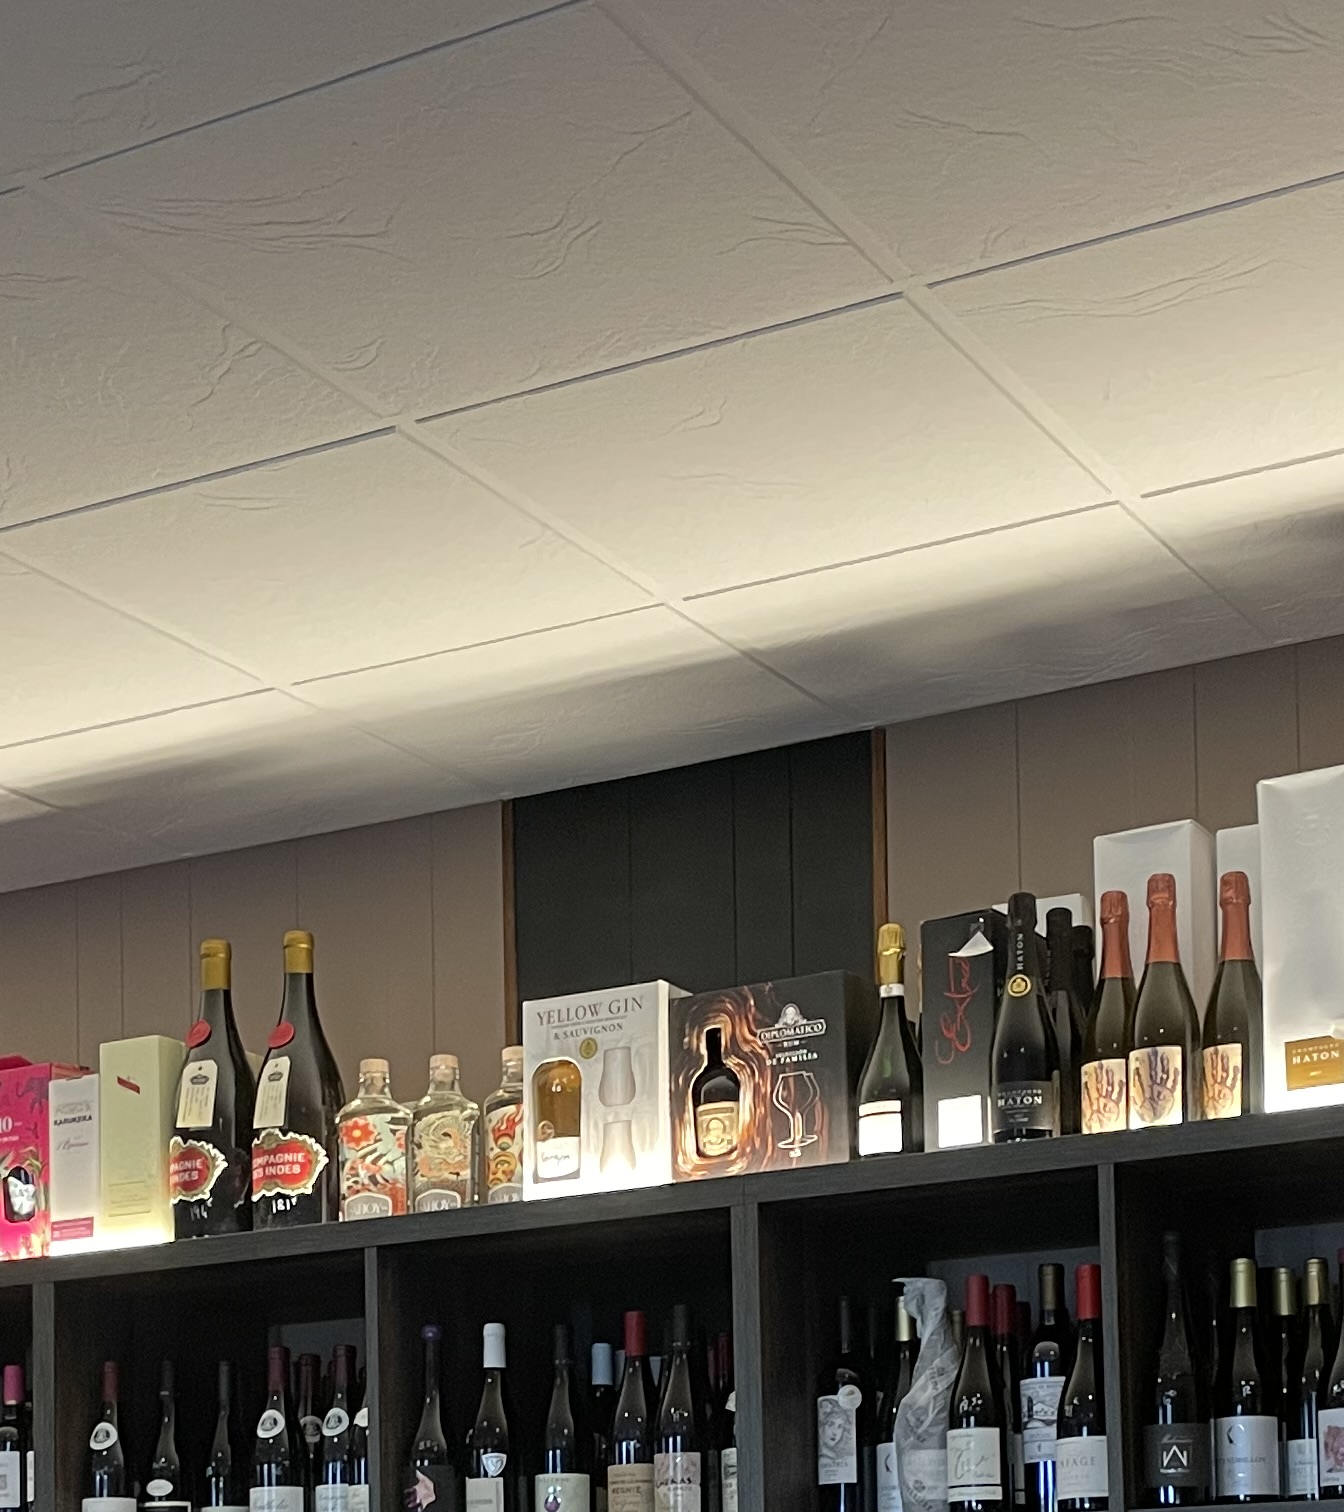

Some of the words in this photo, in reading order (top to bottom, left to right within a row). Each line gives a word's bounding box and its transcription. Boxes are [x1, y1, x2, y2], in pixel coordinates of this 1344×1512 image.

[537, 1002, 603, 1026] YELLOW
[609, 996, 644, 1015] GIN
[553, 1032, 560, 1040] &
[563, 1023, 623, 1039] SAUVIGNON
[760, 1023, 823, 1040] DIPLOMATICO
[1292, 1050, 1340, 1064] HATON
[997, 1096, 1042, 1107] HATON
[265, 1164, 301, 1176] INDES
